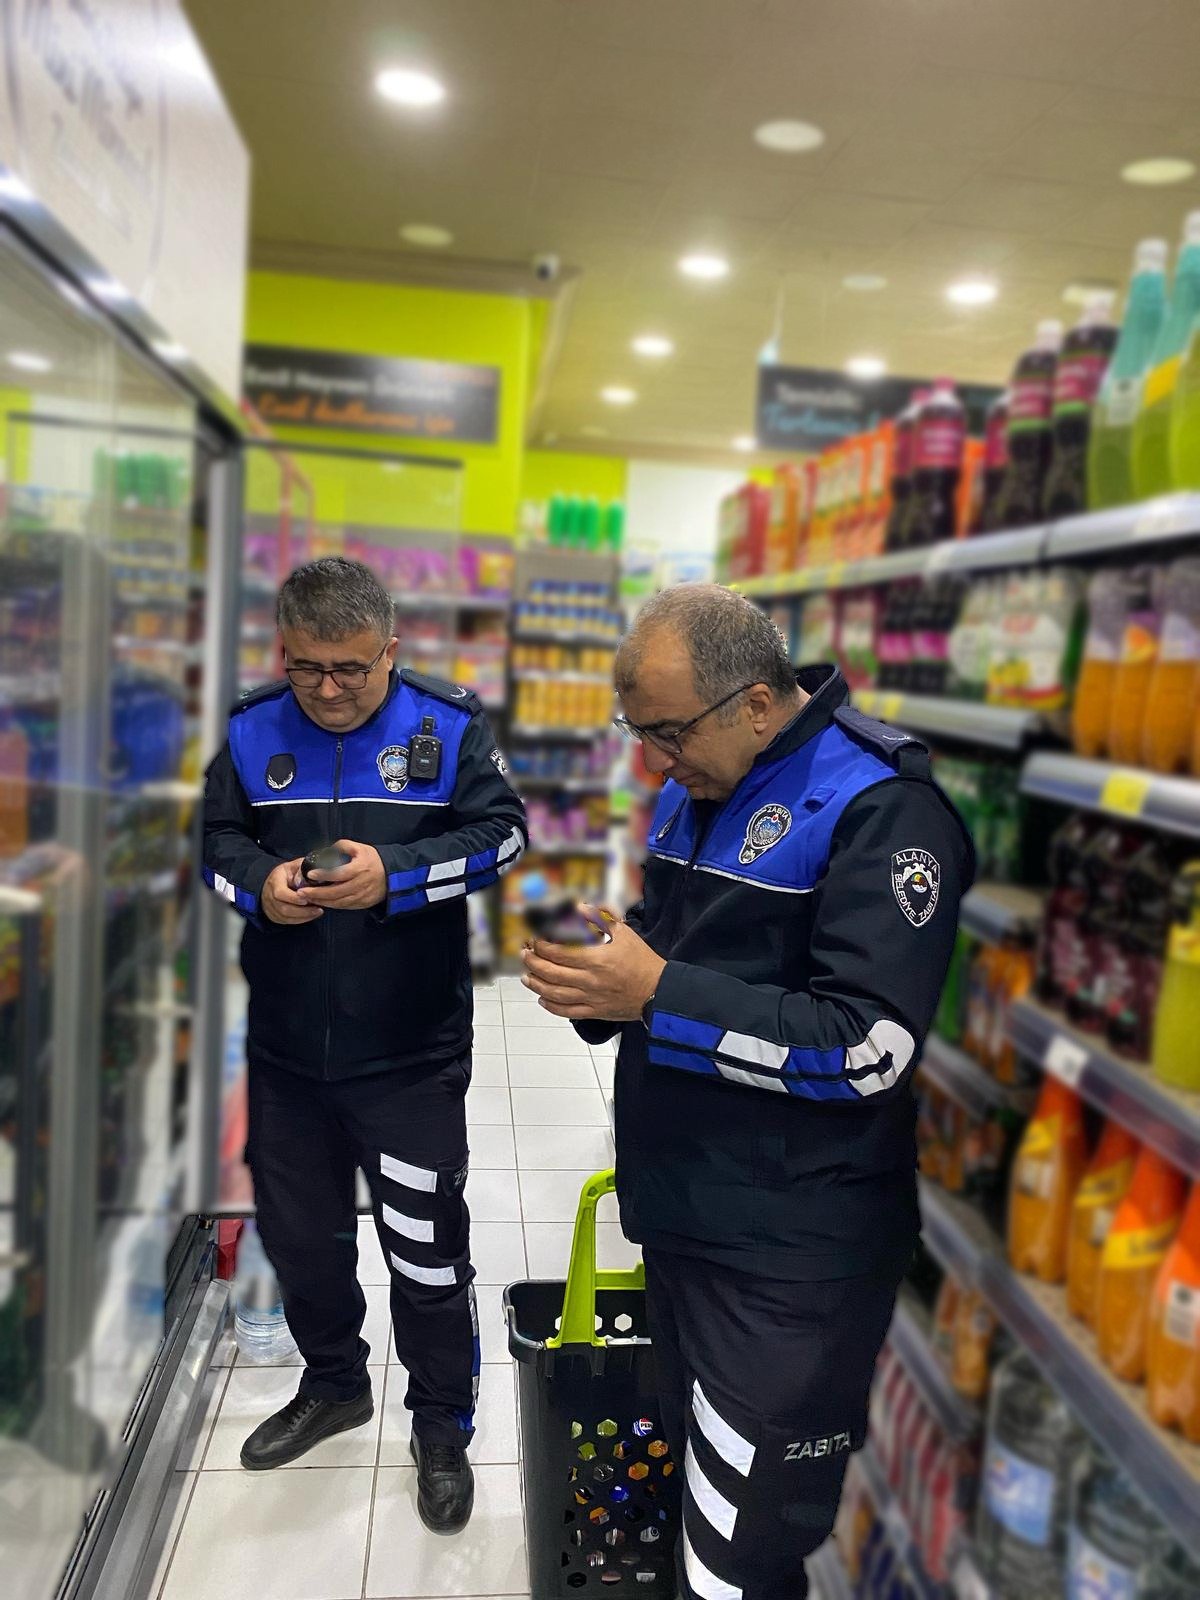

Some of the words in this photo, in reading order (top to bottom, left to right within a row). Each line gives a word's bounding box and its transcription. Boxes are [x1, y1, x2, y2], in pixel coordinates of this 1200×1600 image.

[767, 806, 789, 820] ZABITA
[895, 851, 938, 874] ALANYA
[784, 1432, 850, 1461] ZABITA
